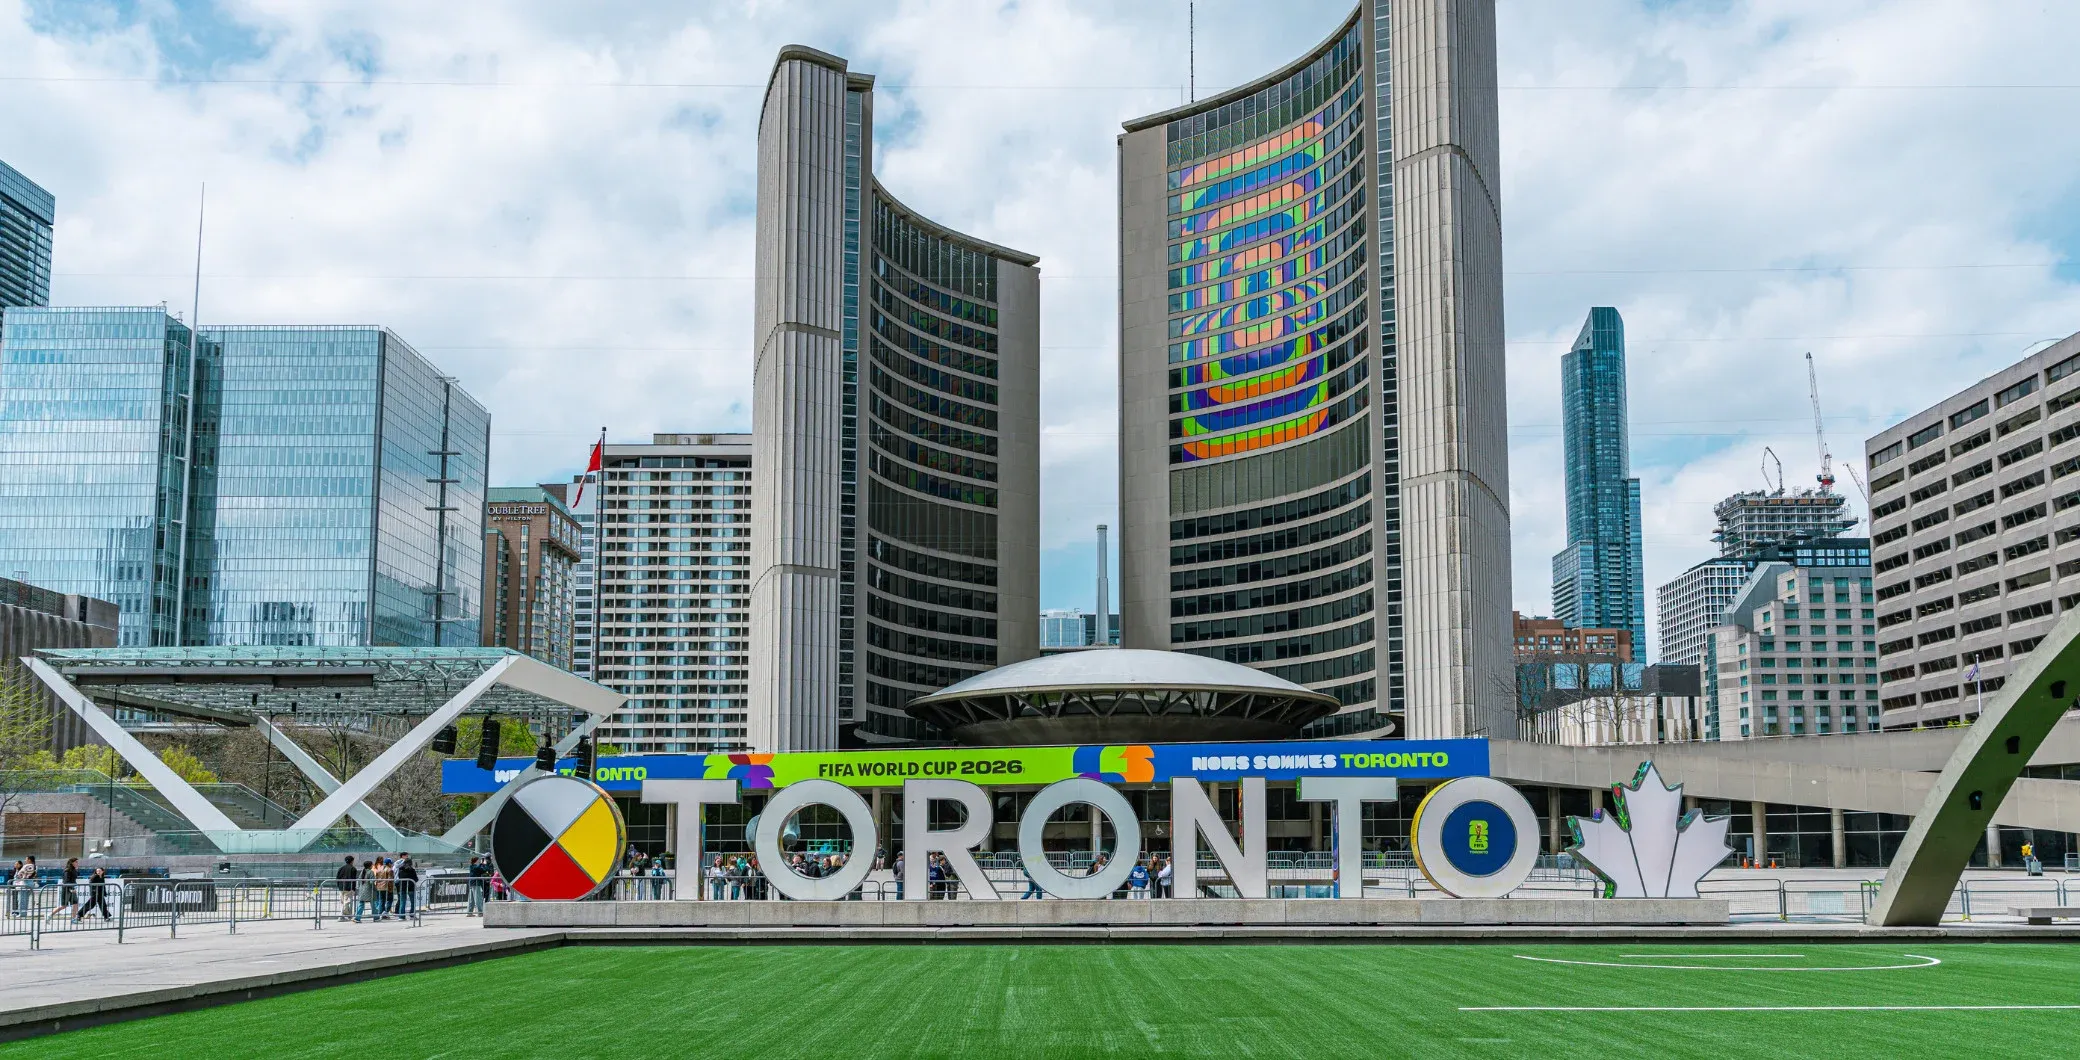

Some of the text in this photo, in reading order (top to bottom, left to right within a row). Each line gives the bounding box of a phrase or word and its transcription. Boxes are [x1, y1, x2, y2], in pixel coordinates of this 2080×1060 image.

[488, 505, 546, 515] OUBLETREE
[818, 760, 1023, 777] FIFA WORLD CUP 2026
[1192, 752, 1449, 771] NOUS SOMMES TORONTO
[560, 767, 647, 781] TONTO
[641, 776, 1540, 900] TORONTO
